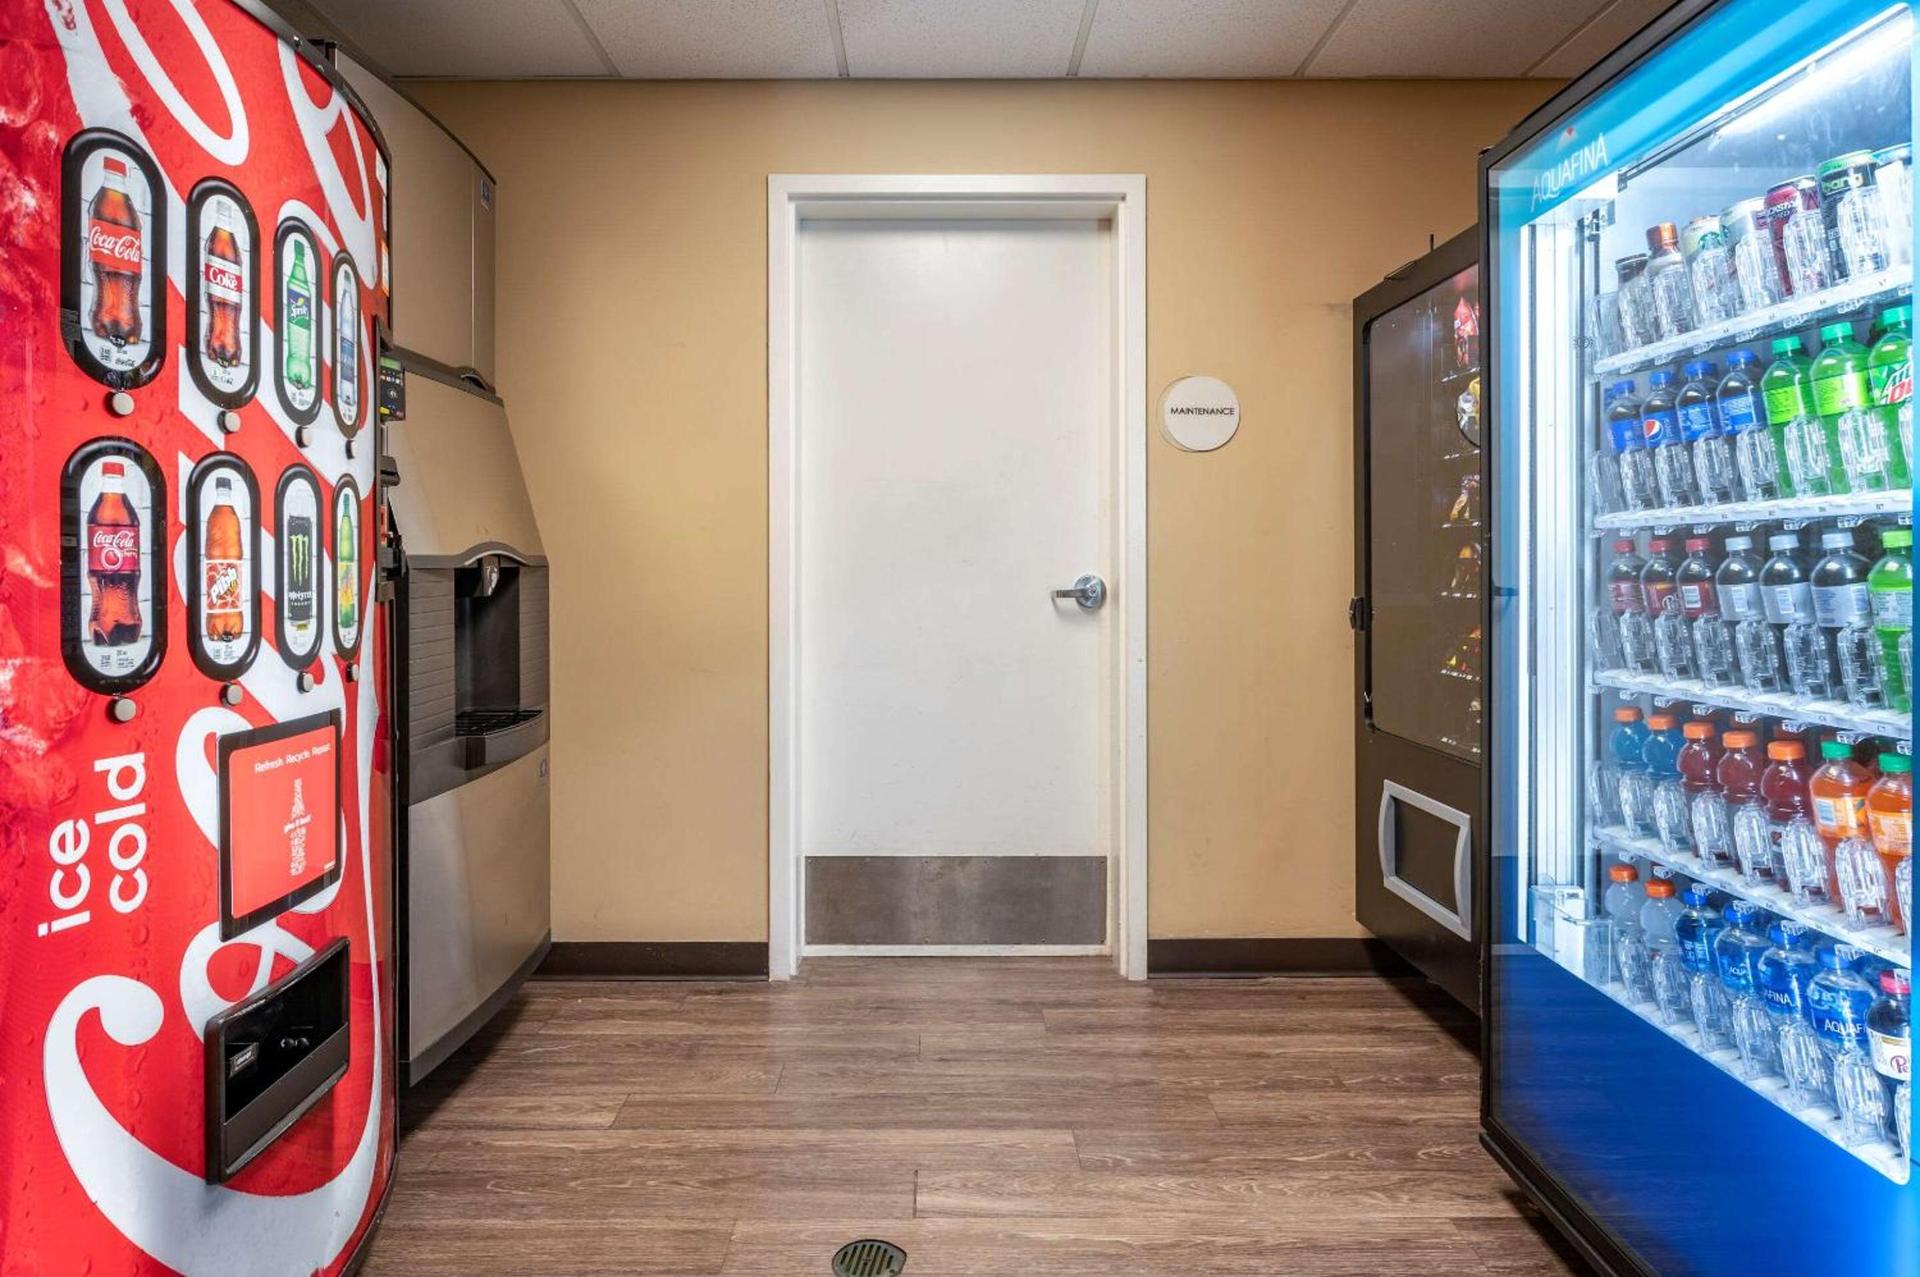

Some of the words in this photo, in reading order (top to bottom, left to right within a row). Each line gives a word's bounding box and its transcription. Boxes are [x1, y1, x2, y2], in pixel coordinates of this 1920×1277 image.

[1531, 132, 1609, 212] AQUAFINA
[89, 226, 141, 262] Coca-Cola
[209, 267, 238, 291] Coke
[1170, 407, 1235, 416] MAINTENANCE
[94, 752, 148, 914] cold
[37, 818, 90, 937] ice
